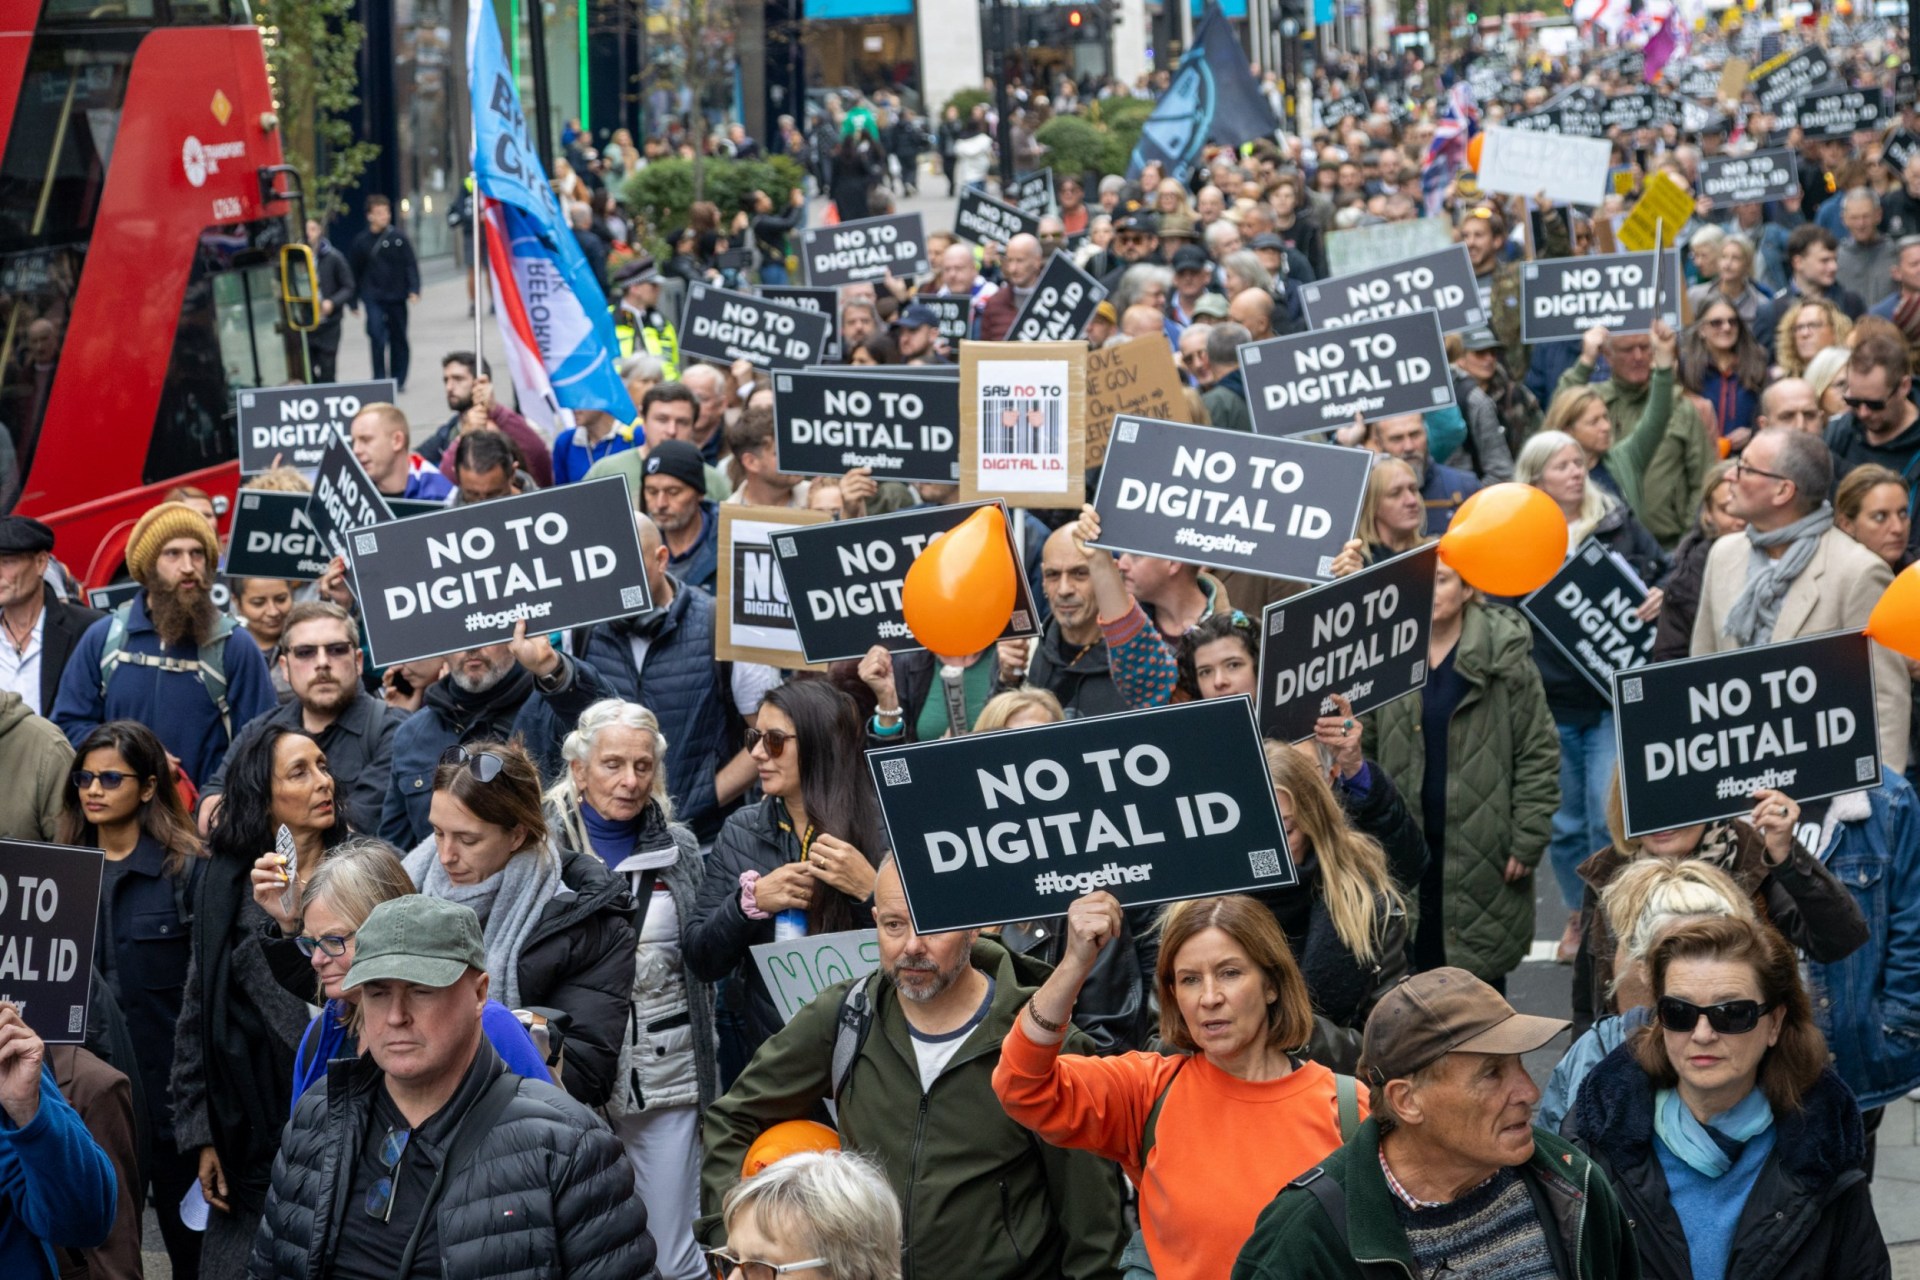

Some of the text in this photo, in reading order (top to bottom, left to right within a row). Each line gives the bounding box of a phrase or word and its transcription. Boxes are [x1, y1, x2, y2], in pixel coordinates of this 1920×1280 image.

[1816, 95, 1842, 112] NO
[1705, 174, 1769, 195] DIGITAL
[1769, 168, 1789, 186] ID
[1721, 156, 1774, 178] NO TO
[977, 202, 1022, 232] NO TO
[834, 225, 898, 250] NO TO
[814, 241, 918, 273] DIGITAL ID
[1346, 266, 1434, 308] NO TO
[1562, 264, 1643, 292] NO TO
[1032, 286, 1059, 318] TO
[1061, 281, 1083, 309] ID
[1433, 284, 1464, 311] ID
[1534, 289, 1634, 319] DIGITAL
[722, 301, 759, 327] NO
[762, 310, 796, 336] TO
[692, 316, 811, 361] DIGITAL ID
[1294, 333, 1397, 374] NO TO
[1087, 349, 1123, 373] OVE
[982, 385, 1010, 398] SAY
[1040, 385, 1062, 397] TO
[1105, 365, 1138, 391] GOV
[1262, 356, 1431, 411] DIGITAL ID
[279, 395, 361, 422] NO TO
[824, 390, 924, 420] NO TO
[1320, 396, 1386, 419] #together
[790, 418, 954, 451] DIGITAL ID
[842, 452, 904, 469] #together
[1172, 445, 1305, 494] NO TO
[317, 474, 356, 535] DIGIT
[337, 465, 359, 507] NO
[357, 494, 377, 526] TO
[1116, 477, 1332, 540] DIGITAL ID
[291, 507, 313, 530] N
[247, 530, 330, 557] DIGI
[426, 512, 568, 569] NO TO
[836, 530, 946, 577] NO T
[1174, 527, 1258, 556] #together
[383, 545, 617, 621] DIGITAL ID
[464, 601, 552, 632] #together
[743, 600, 786, 617] DIGITAL
[806, 579, 905, 622] DIGIT
[1312, 583, 1400, 649] NO TO
[1600, 587, 1644, 633] NO
[1274, 617, 1419, 707] DIGITAL ID
[1688, 666, 1817, 724] NO TO
[1644, 707, 1856, 782] DIGITAL ID
[976, 744, 1171, 810] NO TO
[1716, 768, 1797, 799] #together
[923, 791, 1241, 874] DIGITAL ID
[1034, 862, 1153, 896] #together
[18, 875, 59, 923] TO
[47, 938, 78, 982] ID
